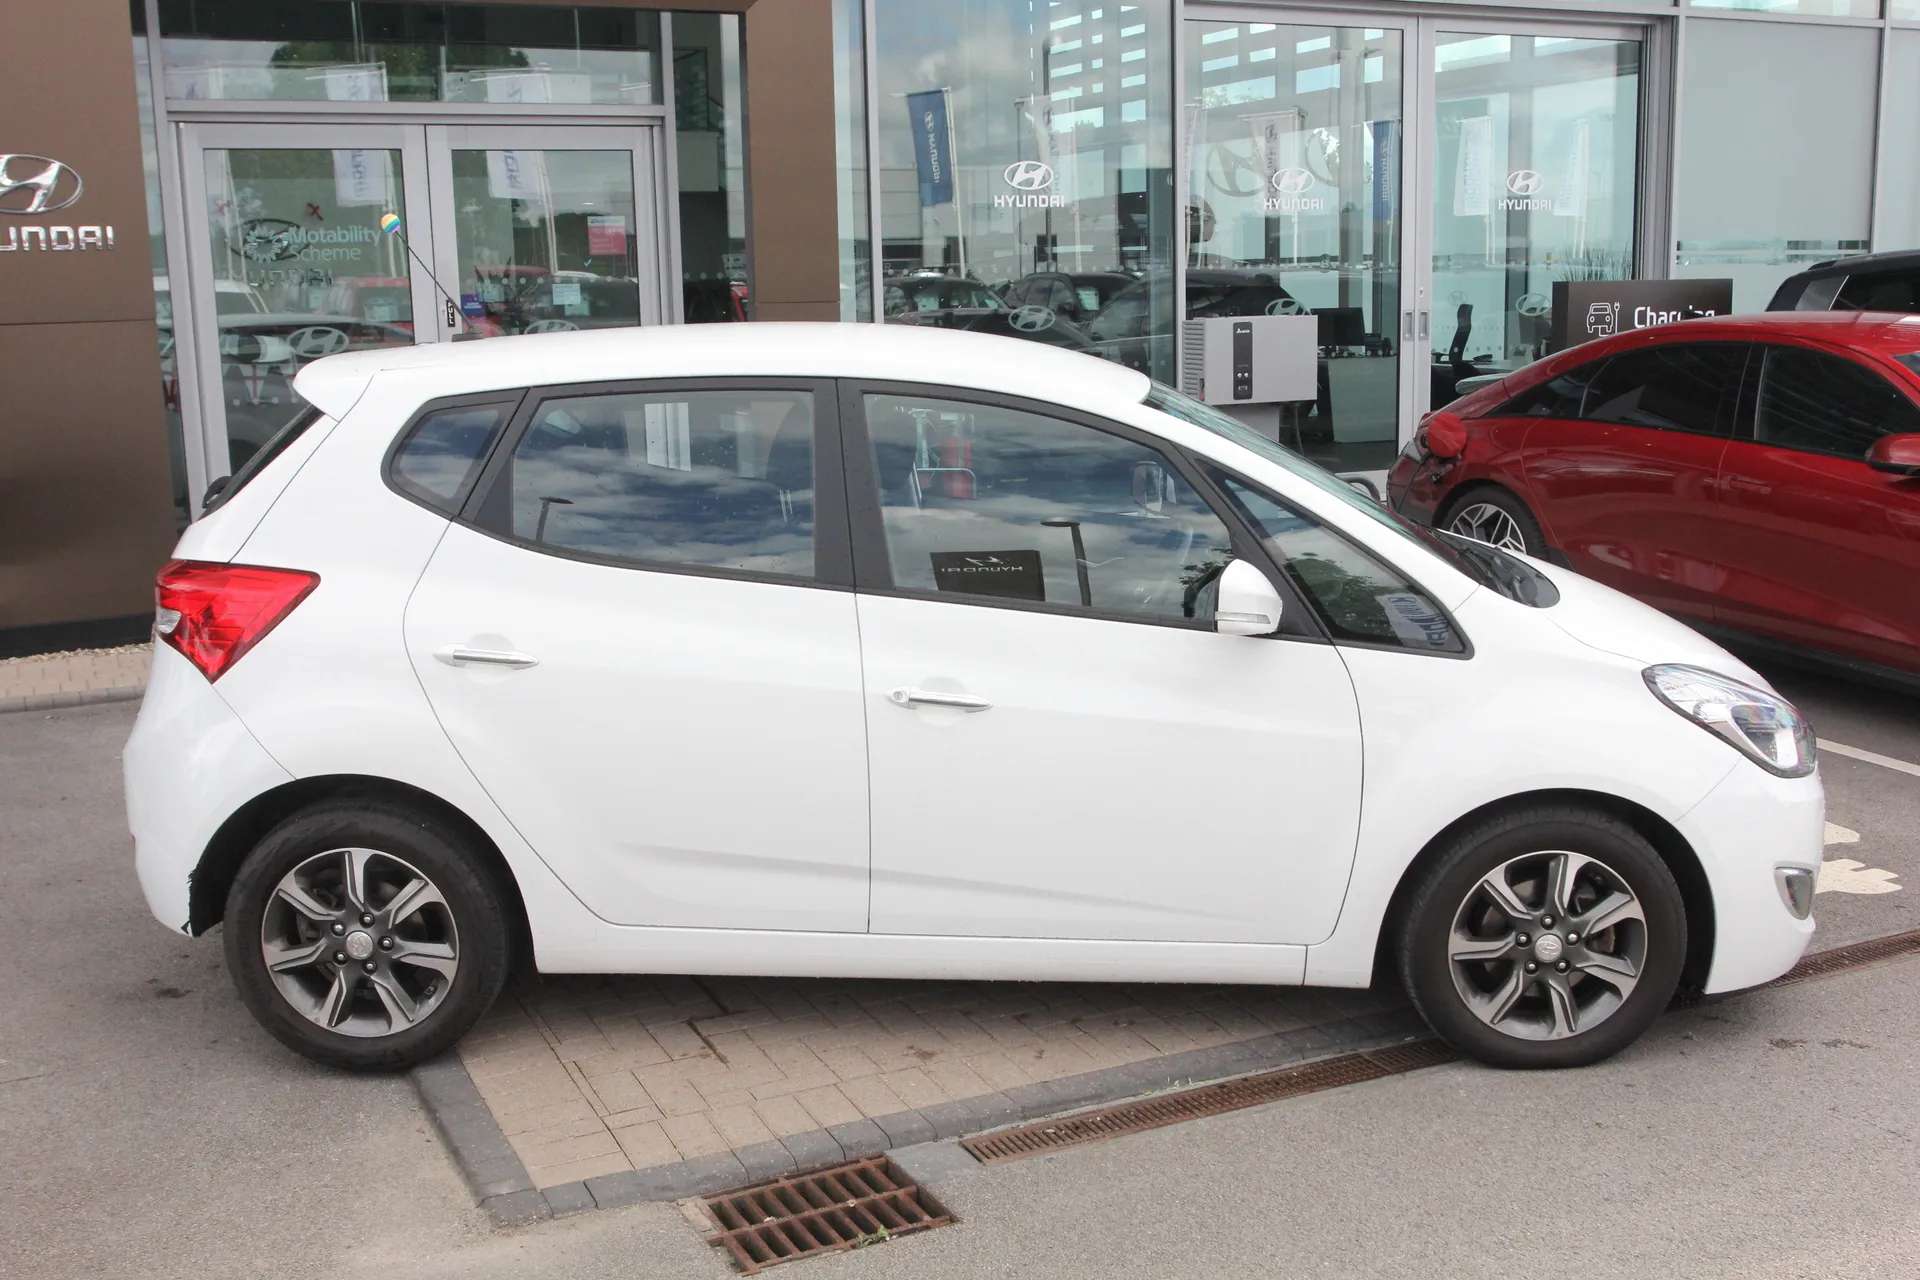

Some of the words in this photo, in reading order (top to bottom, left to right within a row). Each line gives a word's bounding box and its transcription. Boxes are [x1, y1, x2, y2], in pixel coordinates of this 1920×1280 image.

[994, 195, 1065, 208] HYUNDAI
[1264, 198, 1324, 209] HYUNDAI
[1498, 199, 1551, 210] HYUNDAI
[288, 225, 382, 246] Motability
[289, 245, 361, 261] Scheme
[1634, 304, 1715, 329] Char
